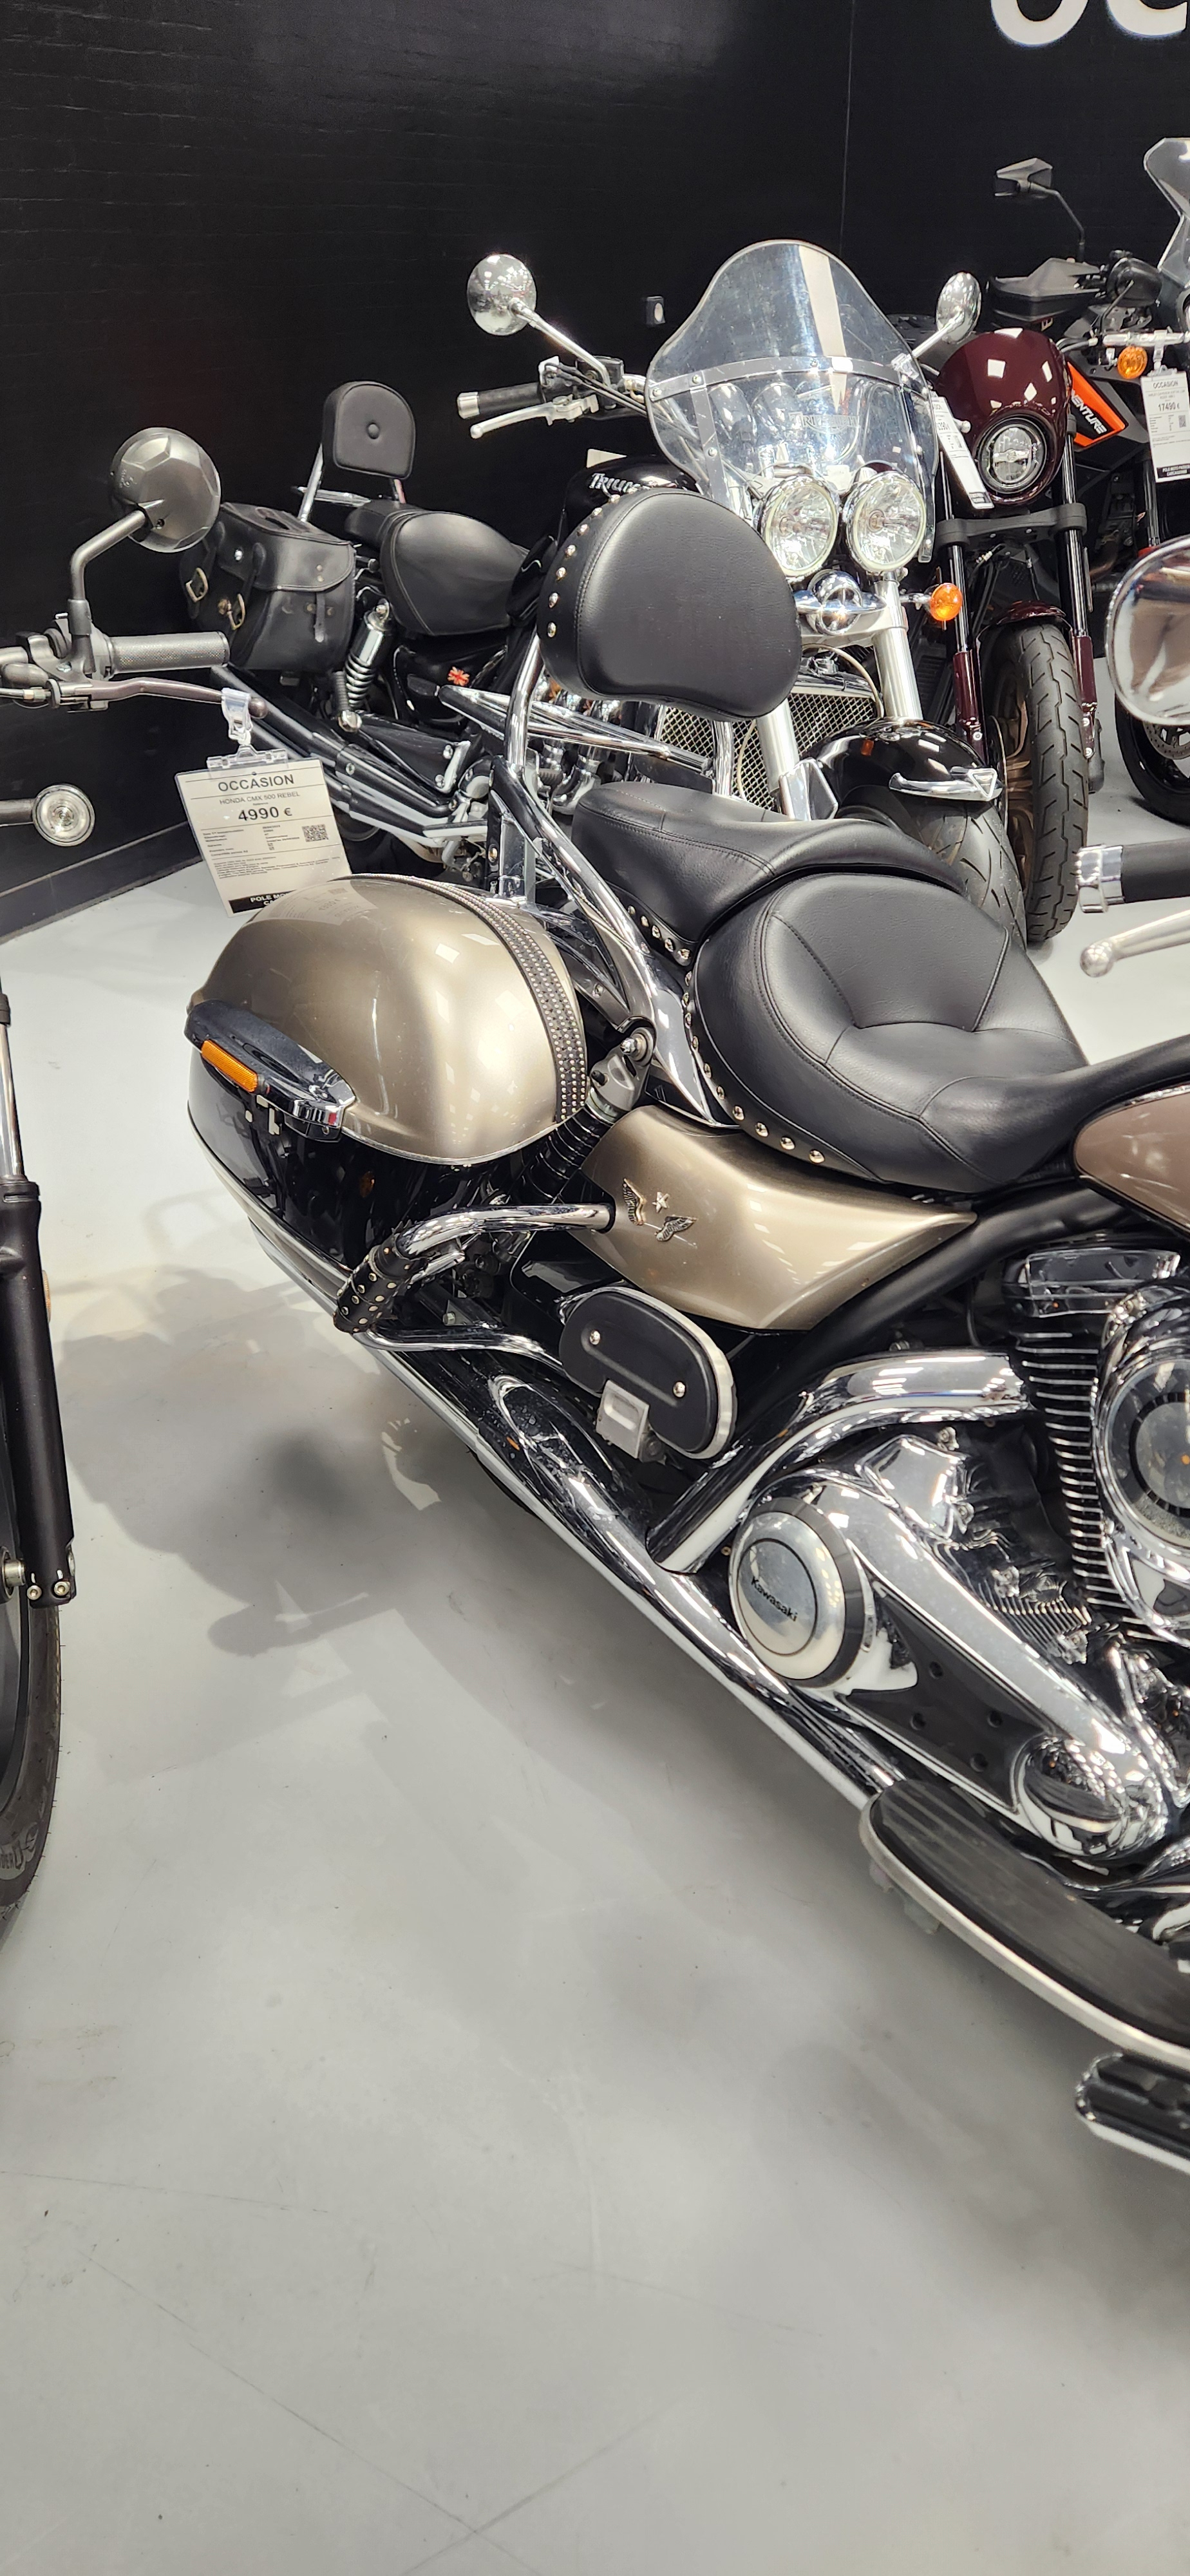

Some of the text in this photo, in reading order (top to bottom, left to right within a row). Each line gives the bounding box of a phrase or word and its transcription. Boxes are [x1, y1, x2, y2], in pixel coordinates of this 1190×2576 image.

[218, 774, 294, 791] OCCASION
[238, 806, 292, 821] 4990 €
[250, 895, 272, 903] POLE
[751, 1576, 798, 1622] Kawasaki
